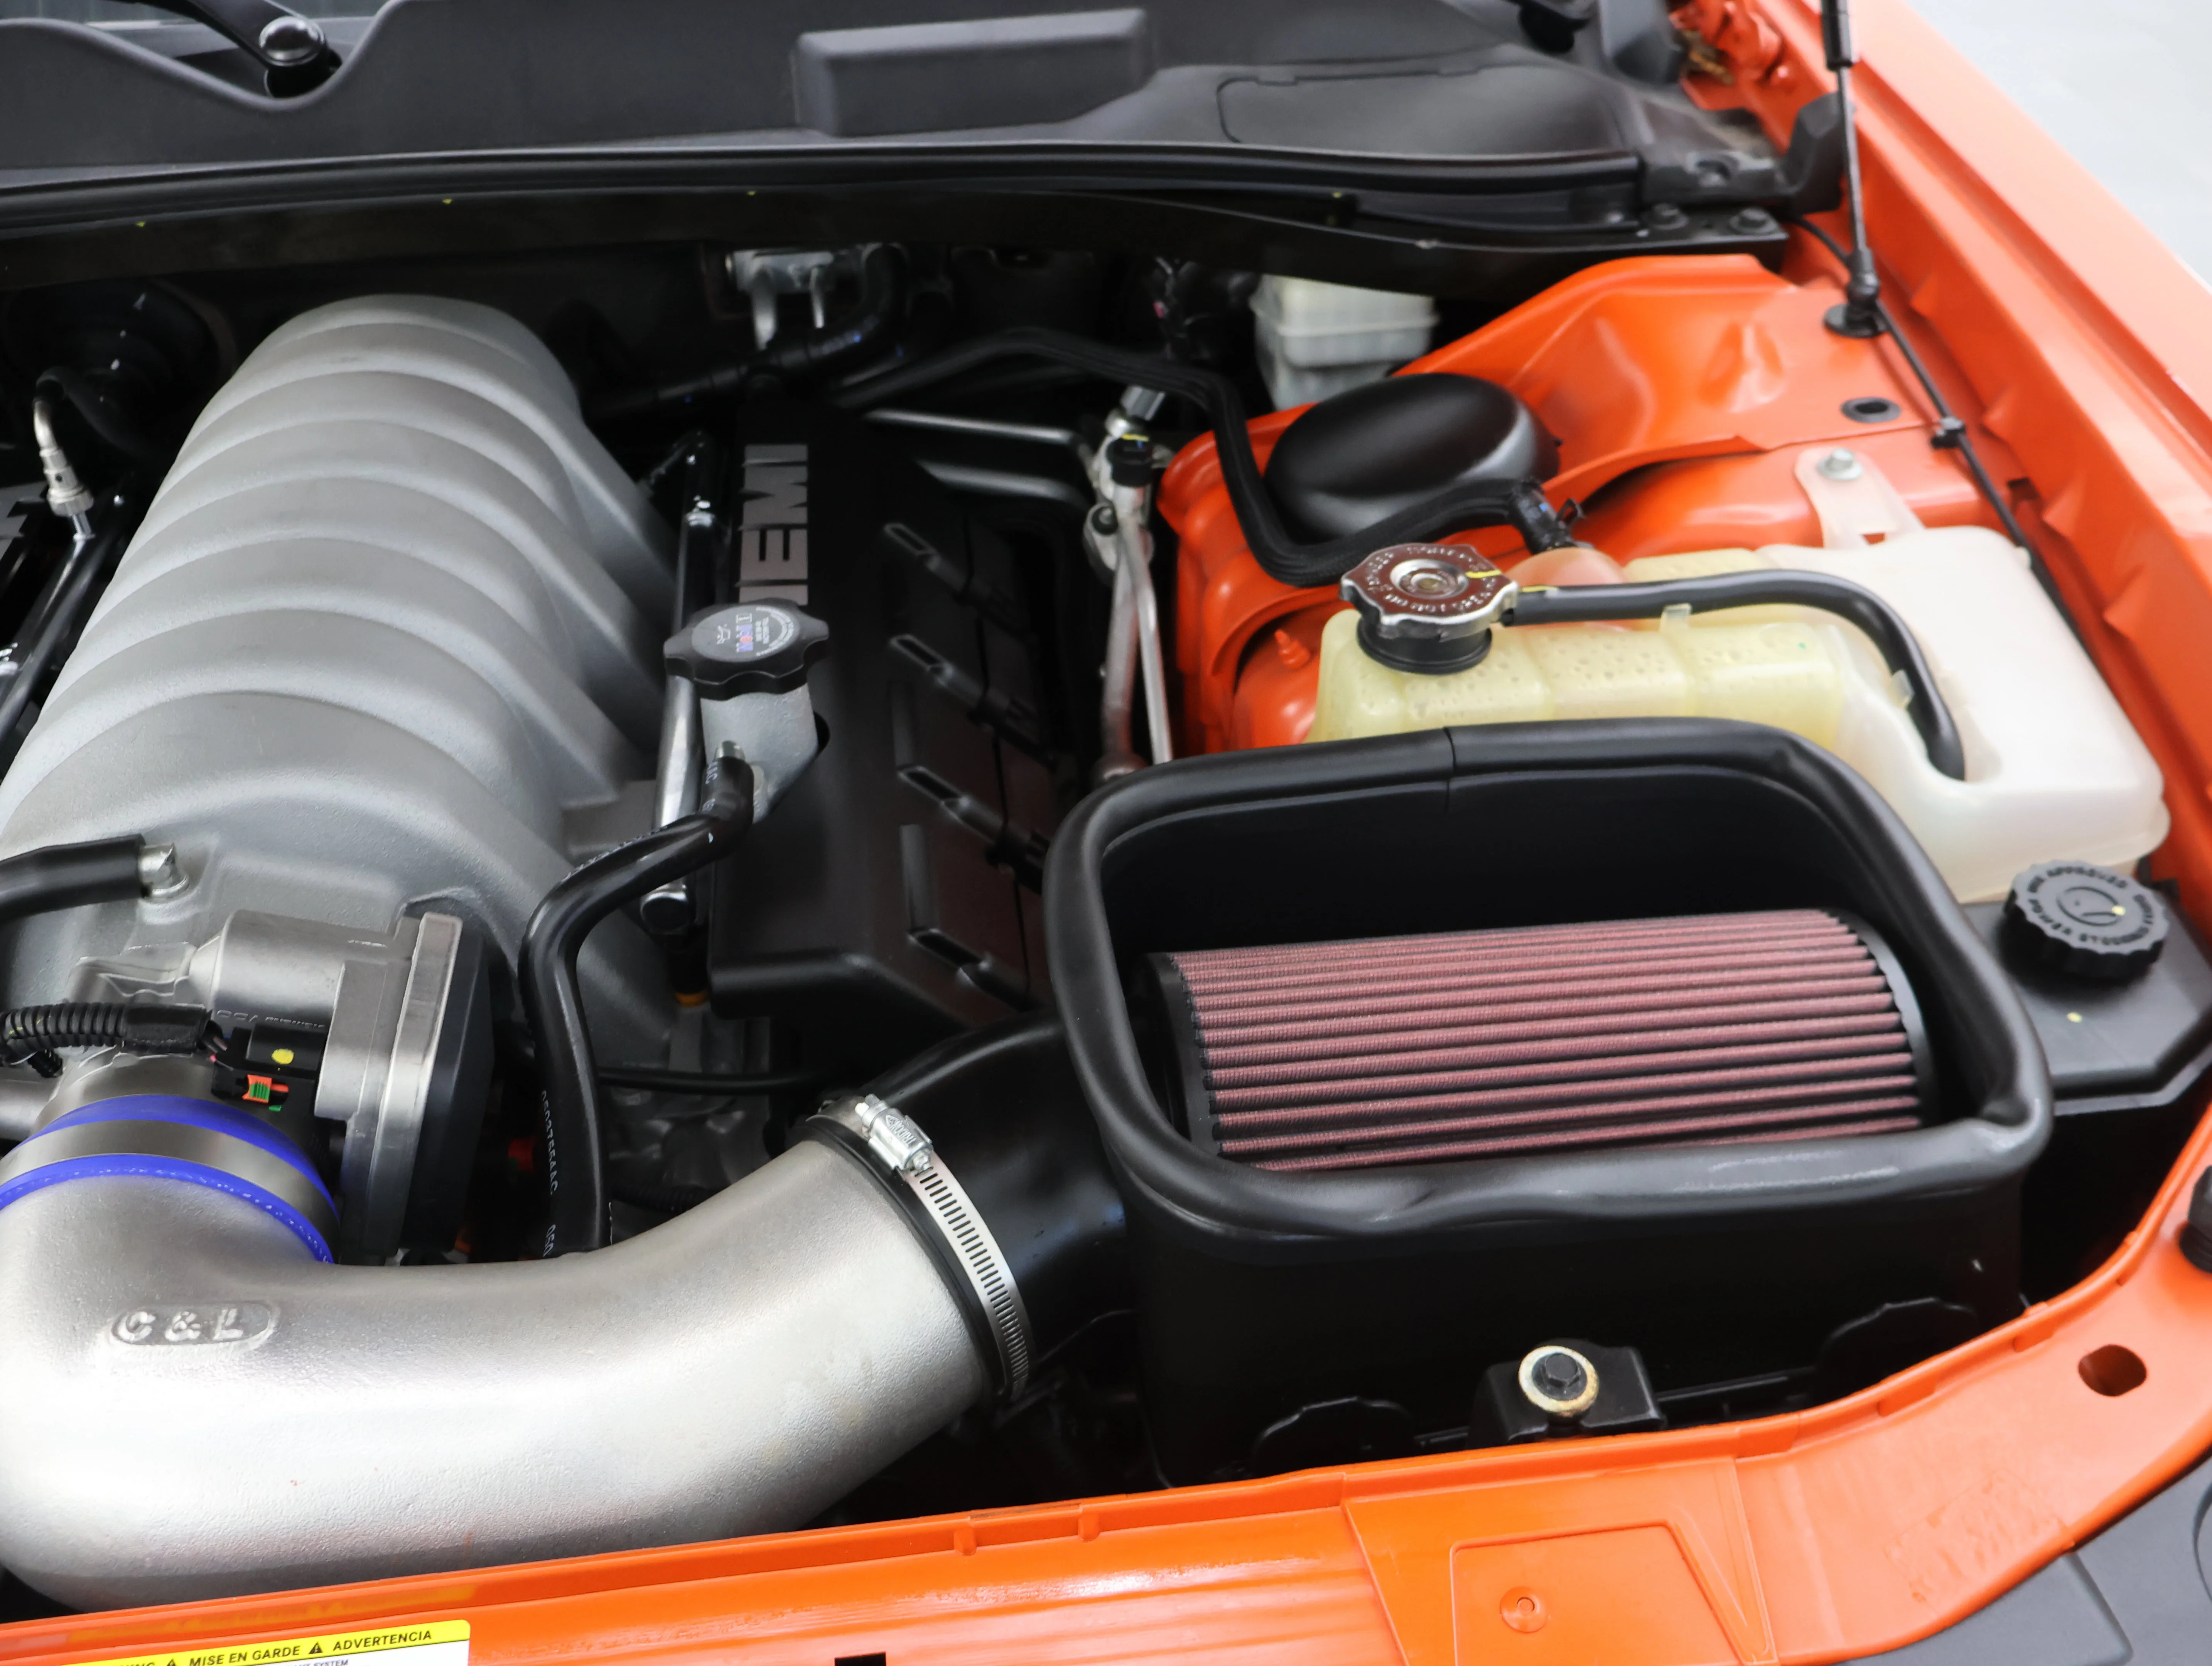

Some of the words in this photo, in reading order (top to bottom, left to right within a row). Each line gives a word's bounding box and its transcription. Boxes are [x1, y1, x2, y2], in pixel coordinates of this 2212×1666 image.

[189, 1654, 224, 1666] MISE
[229, 1652, 248, 1663] EN
[252, 1646, 301, 1660] GARDE
[333, 1630, 432, 1651] ADVERTENCIA
